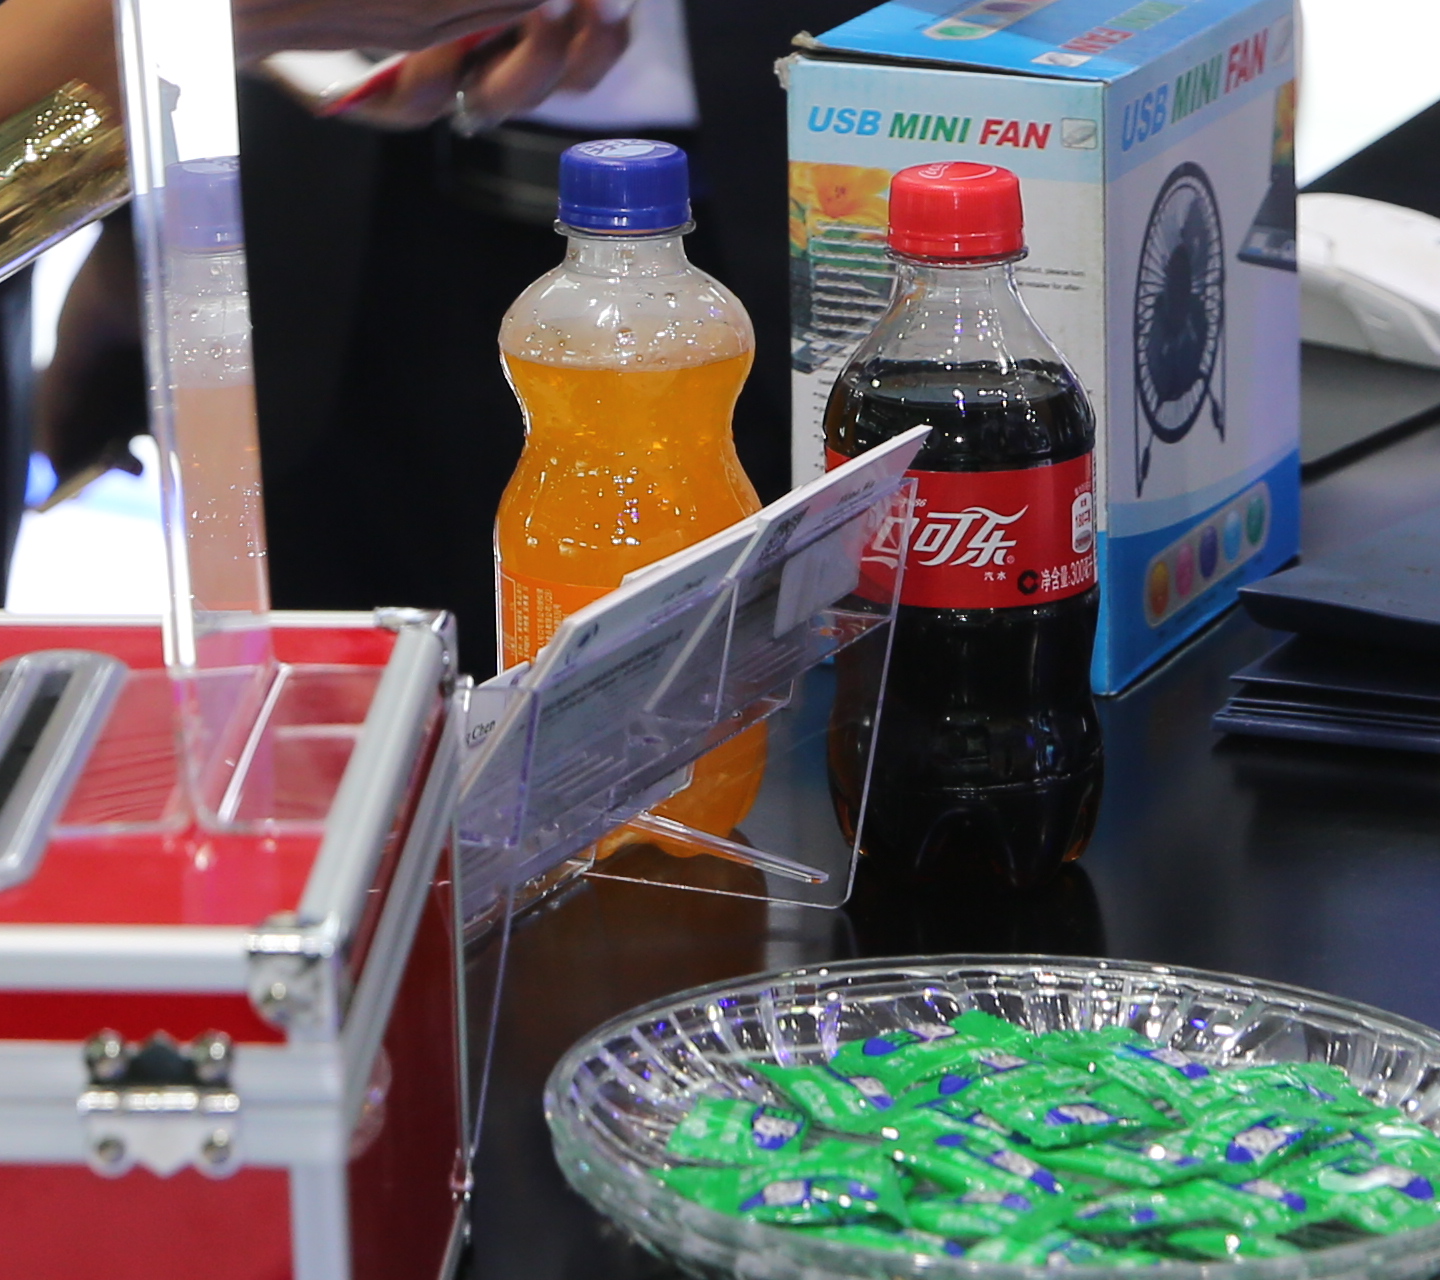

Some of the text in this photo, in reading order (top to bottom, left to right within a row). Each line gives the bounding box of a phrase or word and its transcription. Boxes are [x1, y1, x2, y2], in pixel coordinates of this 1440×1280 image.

[1121, 27, 1269, 152] USB MINI FAN
[807, 105, 1053, 150] USB MINI FAN
[861, 505, 1029, 569] 口可乐
[984, 571, 1007, 582] 汽水
